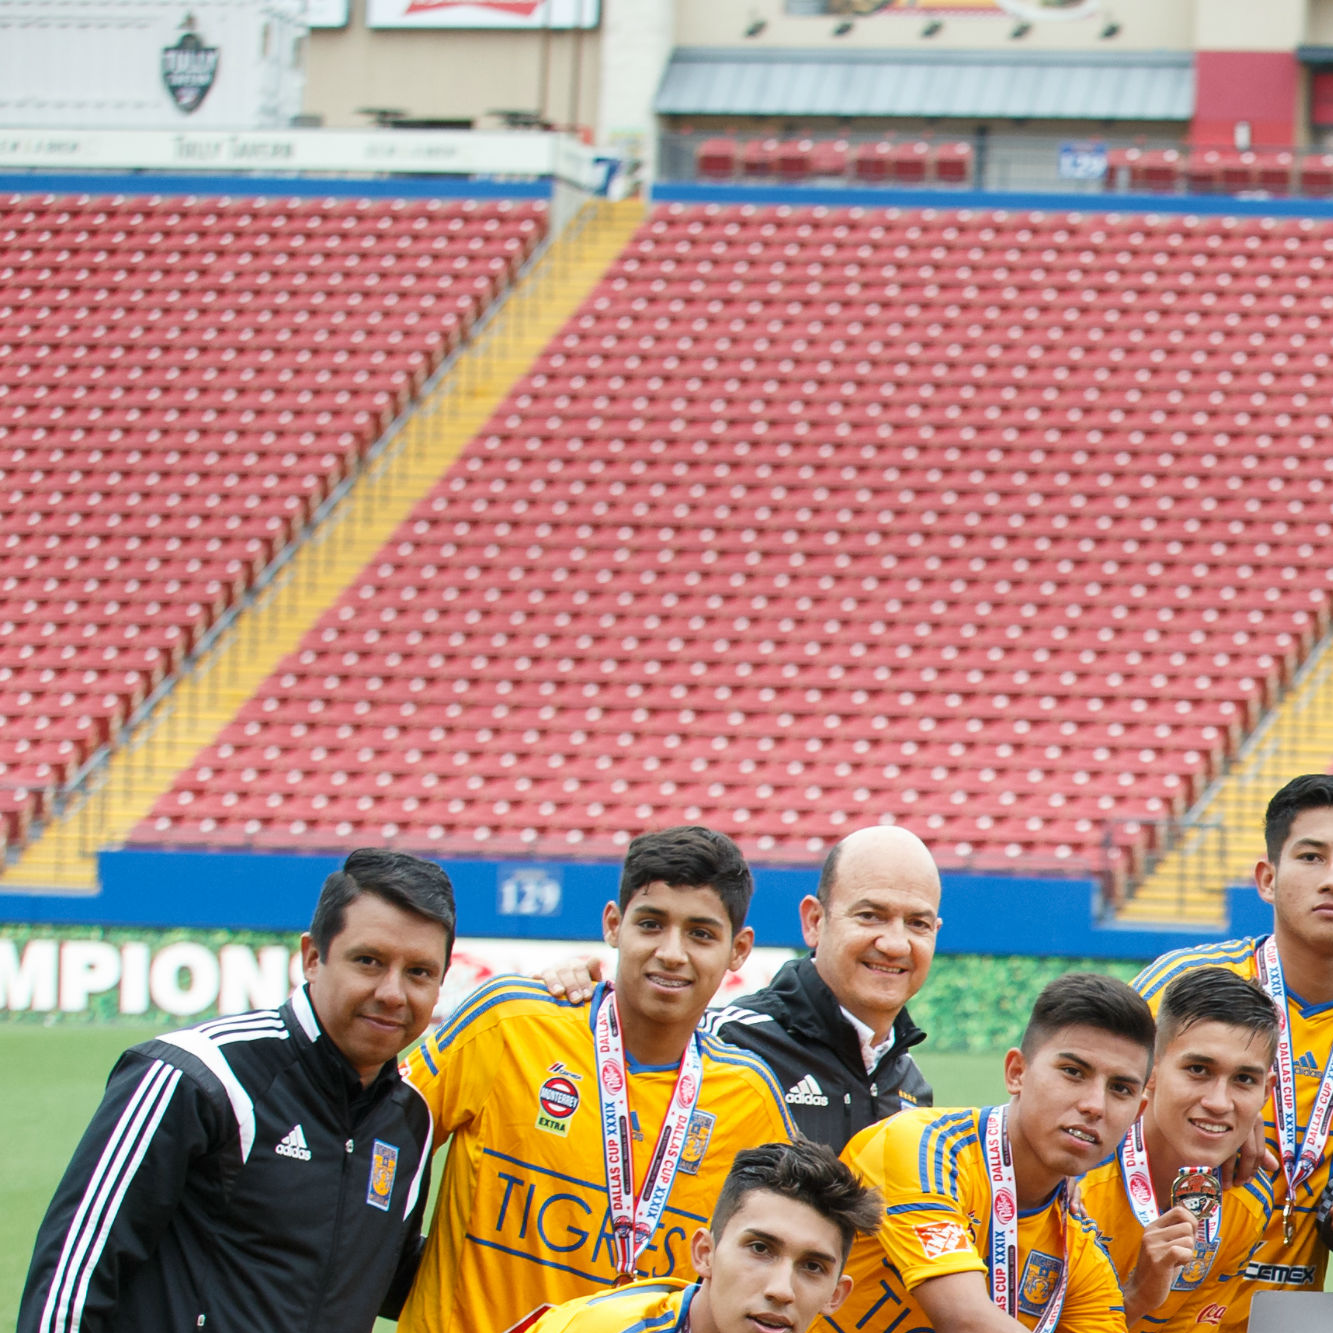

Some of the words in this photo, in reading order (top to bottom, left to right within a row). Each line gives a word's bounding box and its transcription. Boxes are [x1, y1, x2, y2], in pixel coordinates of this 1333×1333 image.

[501, 880, 561, 916] 129
[1280, 1042, 1290, 1081] DALLAS
[540, 1088, 579, 1112] MONTERREY
[786, 1093, 829, 1107] adidas
[1283, 1084, 1292, 1110] CUP
[537, 1116, 566, 1134] EXTRA
[606, 1101, 616, 1138] XXXIX
[988, 1118, 998, 1141] CUP
[1285, 1112, 1295, 1145] XXXIX
[1307, 1107, 1324, 1147] DALLAS
[275, 1142, 312, 1162] adidas
[610, 1140, 619, 1166] CUP
[990, 1142, 1001, 1182] DALLAS
[612, 1166, 621, 1211] DALLAS
[994, 1229, 1005, 1266] XXXIX
